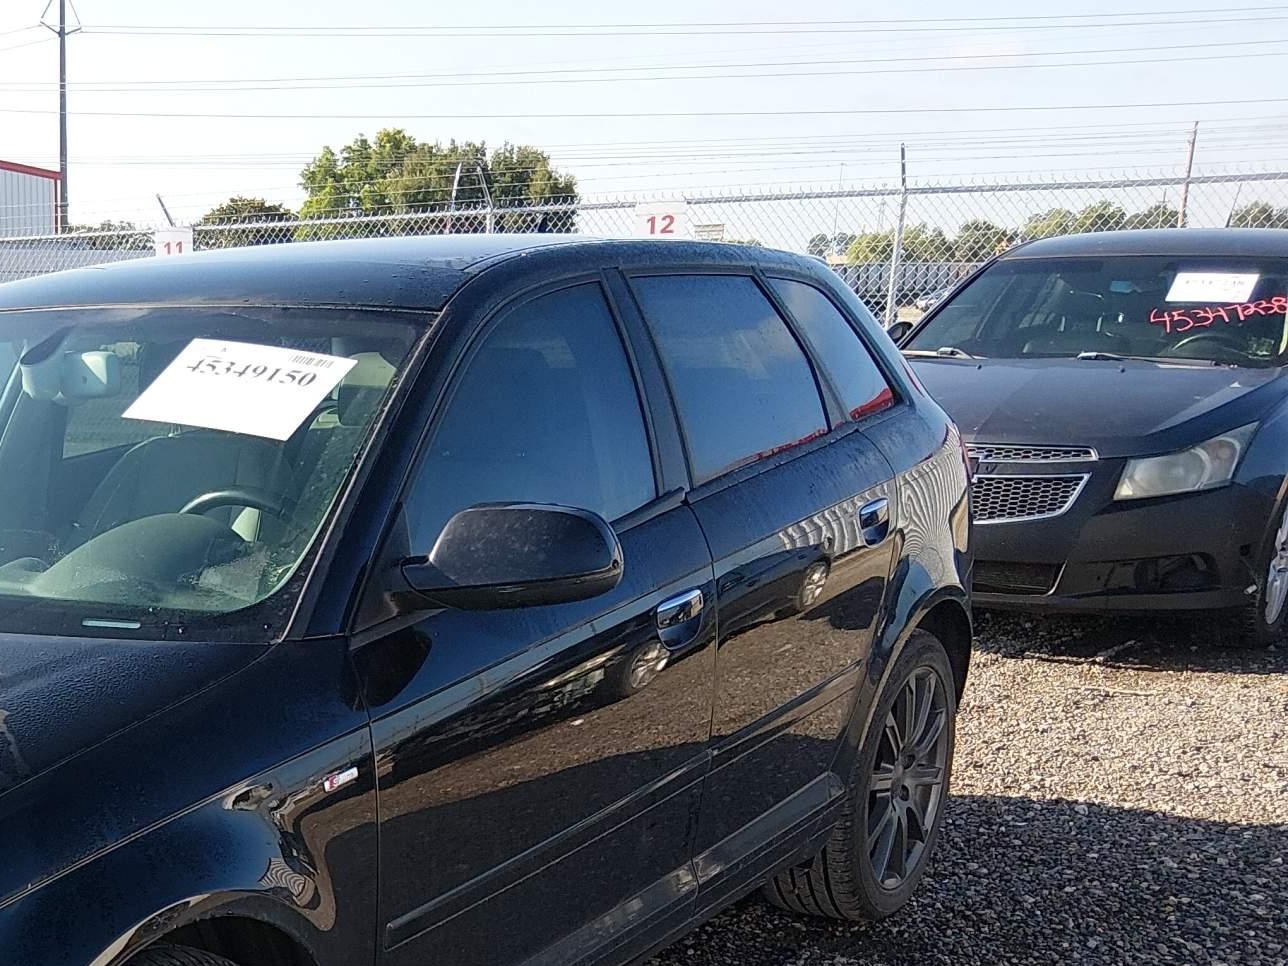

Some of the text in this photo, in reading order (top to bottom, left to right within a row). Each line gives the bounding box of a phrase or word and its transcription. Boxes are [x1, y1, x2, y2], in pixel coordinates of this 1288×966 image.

[646, 214, 675, 234] 12
[163, 240, 183, 255] 11
[1150, 296, 1288, 333] 45347238
[186, 358, 317, 387] 45349150
